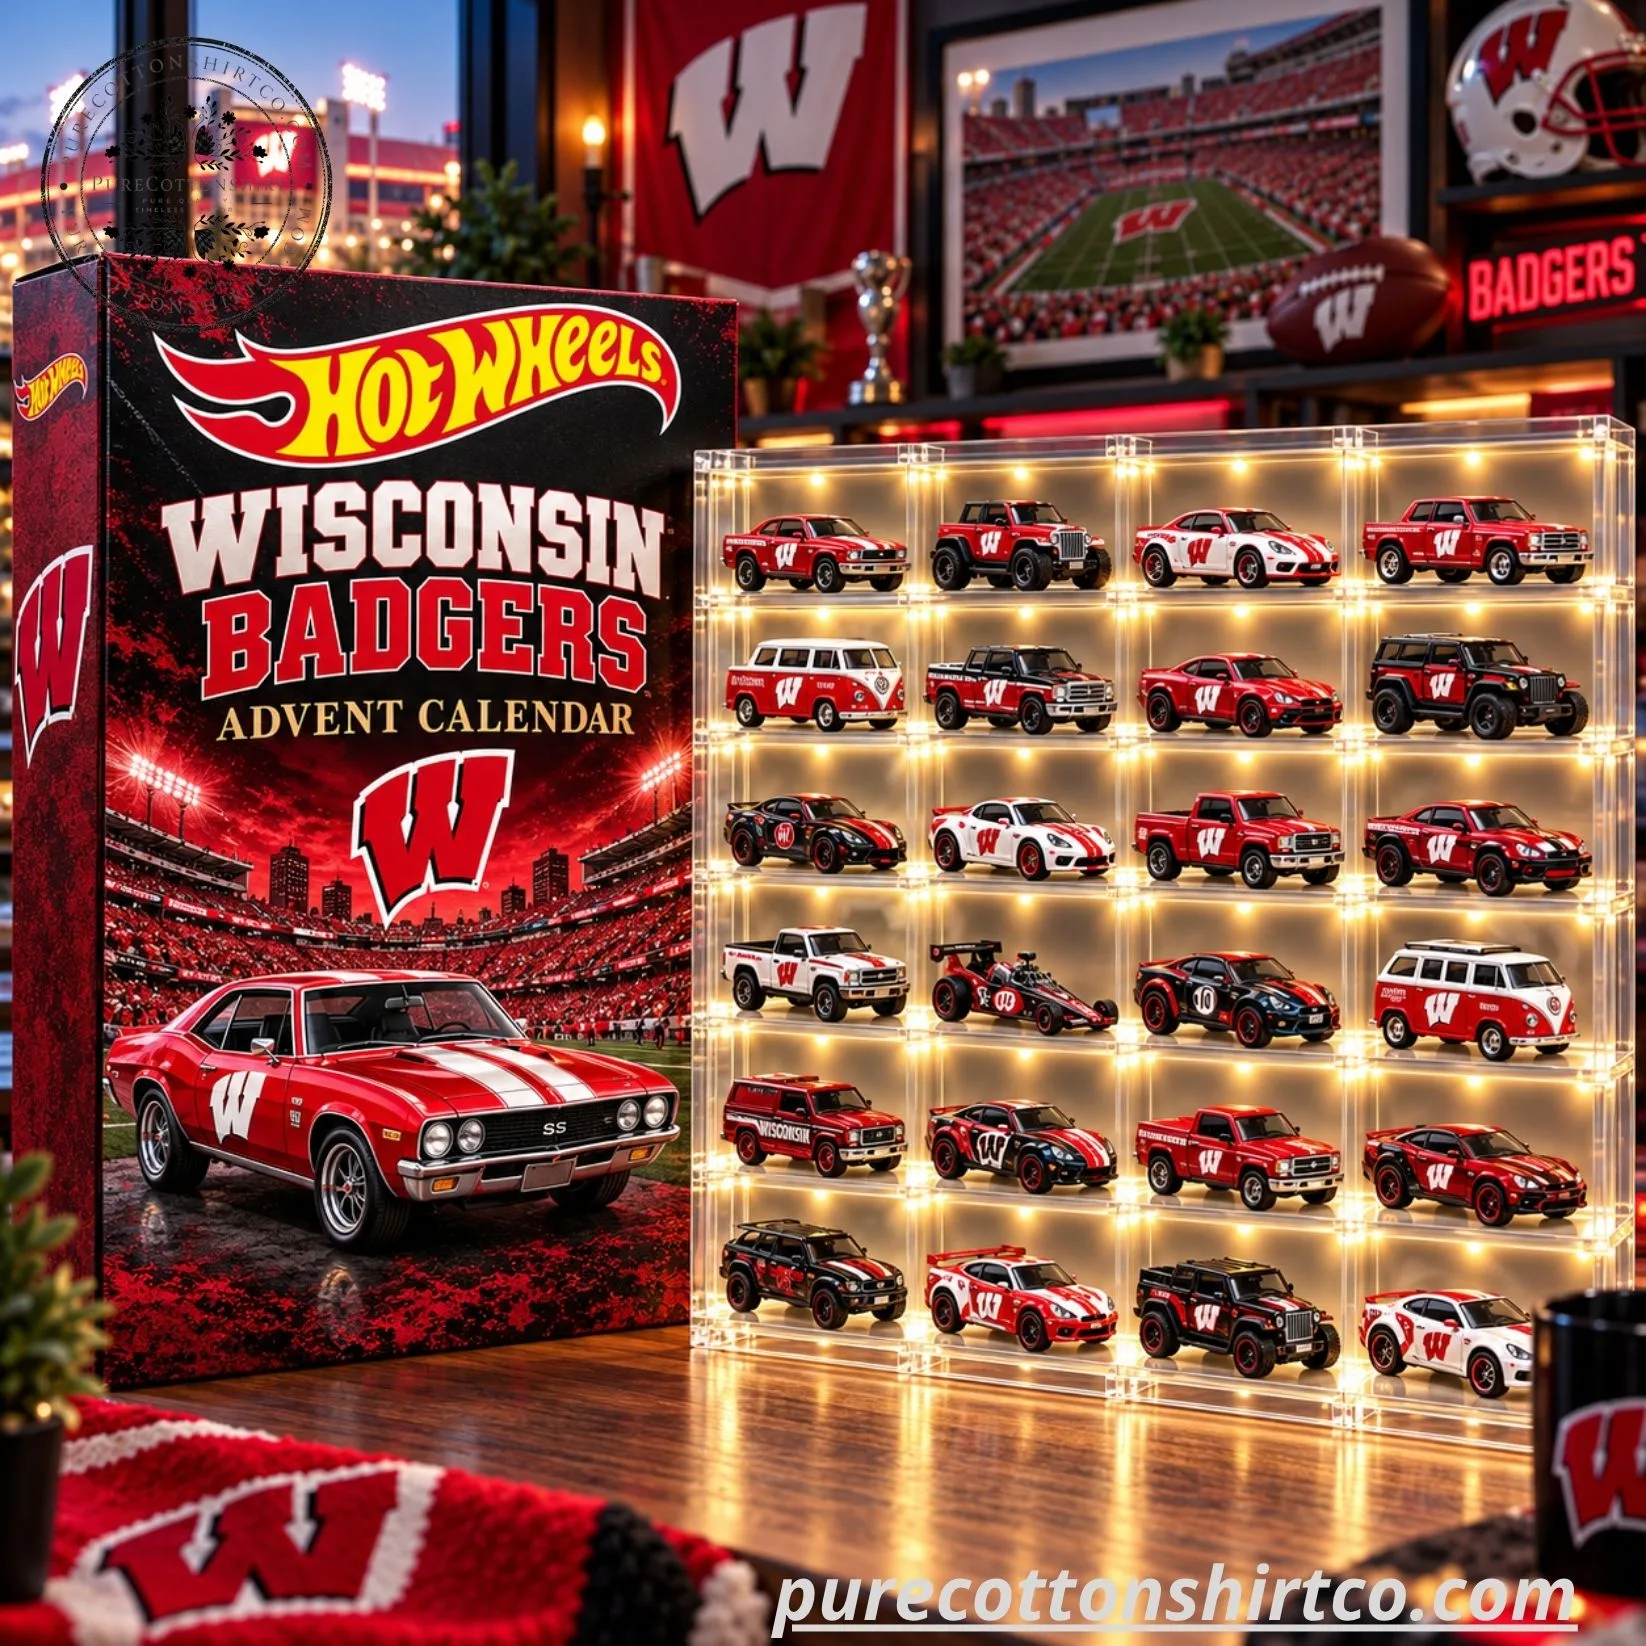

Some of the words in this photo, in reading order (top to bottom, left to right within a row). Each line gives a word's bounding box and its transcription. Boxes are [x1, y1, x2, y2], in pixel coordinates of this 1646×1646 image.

[1478, 8, 1569, 106] W
[665, 1, 867, 220] W
[1113, 198, 1198, 245] W
[1314, 283, 1377, 353] W
[1468, 235, 1636, 322] BADGERS
[160, 480, 665, 600] WISCONSIN
[14, 545, 93, 768] W
[200, 577, 648, 702] BADGERS
[216, 700, 404, 742] ADVENT
[418, 699, 635, 736] CALENDAR
[352, 748, 515, 930] W
[209, 1070, 268, 1145] W
[542, 1121, 567, 1136] SS
[759, 1119, 811, 1145] WISCONSIN
